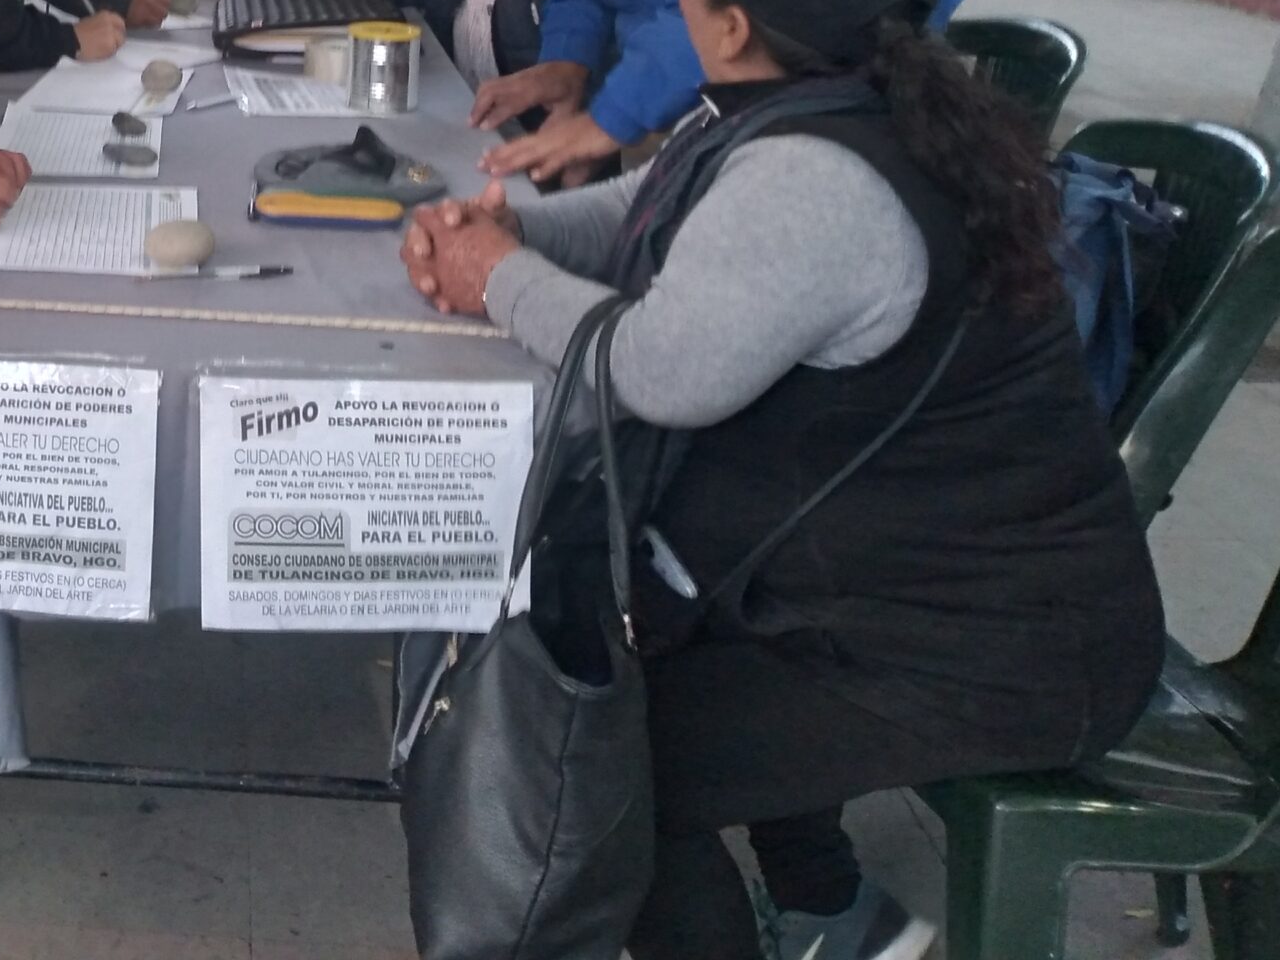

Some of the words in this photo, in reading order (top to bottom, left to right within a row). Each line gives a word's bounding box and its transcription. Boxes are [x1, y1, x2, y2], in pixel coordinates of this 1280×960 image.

[13, 383, 28, 393] LA
[32, 384, 113, 397] REVOCACION
[55, 401, 71, 411] DE
[75, 402, 133, 414] PODERES
[230, 399, 254, 408] Claro
[256, 395, 273, 405] que
[335, 400, 378, 411] APOYO
[382, 401, 398, 411] LA
[402, 401, 486, 412] REVOCACION
[4, 414, 87, 428] MUNICIPALES
[241, 401, 319, 442] Firmo
[328, 415, 423, 428] DESAPARICIÓN
[427, 418, 443, 428] DE
[448, 418, 508, 429] PODERES
[32, 433, 47, 450] TU
[51, 435, 120, 454] DERECHO
[374, 433, 462, 444] MUNICIPALES
[3, 452, 23, 460] POR
[26, 453, 38, 461] EL
[41, 454, 64, 462] BIEN
[68, 455, 81, 463] DE
[84, 456, 120, 466] TODOS,
[234, 448, 322, 466] CIUDADANO
[327, 451, 354, 467] HAS
[358, 451, 400, 468] VALER
[404, 451, 420, 468] TU
[425, 452, 495, 469] DERECHO
[24, 465, 99, 476] RESPONSABLE,
[234, 468, 255, 476] POR
[258, 468, 288, 477] AMOR
[291, 469, 298, 477] A
[301, 470, 371, 479] TULANCINGO,
[374, 471, 396, 479] POR
[399, 471, 411, 479] EL
[442, 472, 455, 480] DE
[459, 472, 496, 480] TODOS,
[6, 475, 59, 485] NUESTRAS
[62, 478, 108, 487] FAMILIAS
[256, 480, 278, 488] CON
[281, 480, 314, 489] VALOR
[318, 481, 344, 489] CIVIL
[357, 482, 393, 490] MORAL
[47, 494, 65, 511] DEL
[68, 495, 113, 513] PUEBLO...
[246, 491, 267, 499] POR
[286, 492, 307, 500] POR
[310, 493, 366, 501] NOSOTROS
[369, 493, 375, 501] Y
[379, 493, 434, 502] NUESTRAS
[437, 494, 485, 502] FAMILIAS
[32, 514, 50, 527] EL
[56, 515, 121, 531] PUEBLO.
[367, 510, 419, 526] INICIATIVA
[422, 510, 440, 526] DEL
[443, 510, 491, 526] PUEBLO...
[233, 511, 343, 540] COCOM
[361, 530, 402, 543] PARA
[408, 530, 426, 543] EL
[432, 530, 498, 543] PUEBLO.
[66, 539, 121, 554] MUNICIPAL
[21, 550, 77, 568] BRAVO,
[83, 556, 121, 569] HGO.
[232, 553, 281, 567] CONSEJO
[284, 554, 345, 568] CIUDADANO
[348, 554, 363, 568] DE
[365, 553, 439, 567] OBSERVACIÓN
[442, 554, 498, 567] MUNICIPAL
[4, 570, 54, 585] FESTIVOS
[57, 574, 71, 586] EN
[73, 576, 85, 589] (O
[87, 577, 127, 592] CERCA)
[232, 569, 253, 581] DE
[259, 569, 365, 581] TULANCINGO
[370, 569, 391, 581] DE
[396, 569, 455, 581] BRAVO,
[7, 584, 43, 598] JARDIN
[45, 588, 64, 599] DEL
[66, 590, 93, 601] ARTE
[284, 590, 341, 602] DOMINGOS
[344, 590, 351, 601] Y
[380, 590, 431, 601] FESTIVOS
[433, 589, 448, 601] EN
[262, 604, 276, 616] DE
[278, 604, 291, 616] LA
[293, 604, 337, 616] VELARIA
[339, 604, 348, 616] O
[350, 604, 365, 616] EN
[367, 604, 380, 615] EL
[382, 604, 419, 615] JARDIN
[422, 604, 439, 615] DEL
